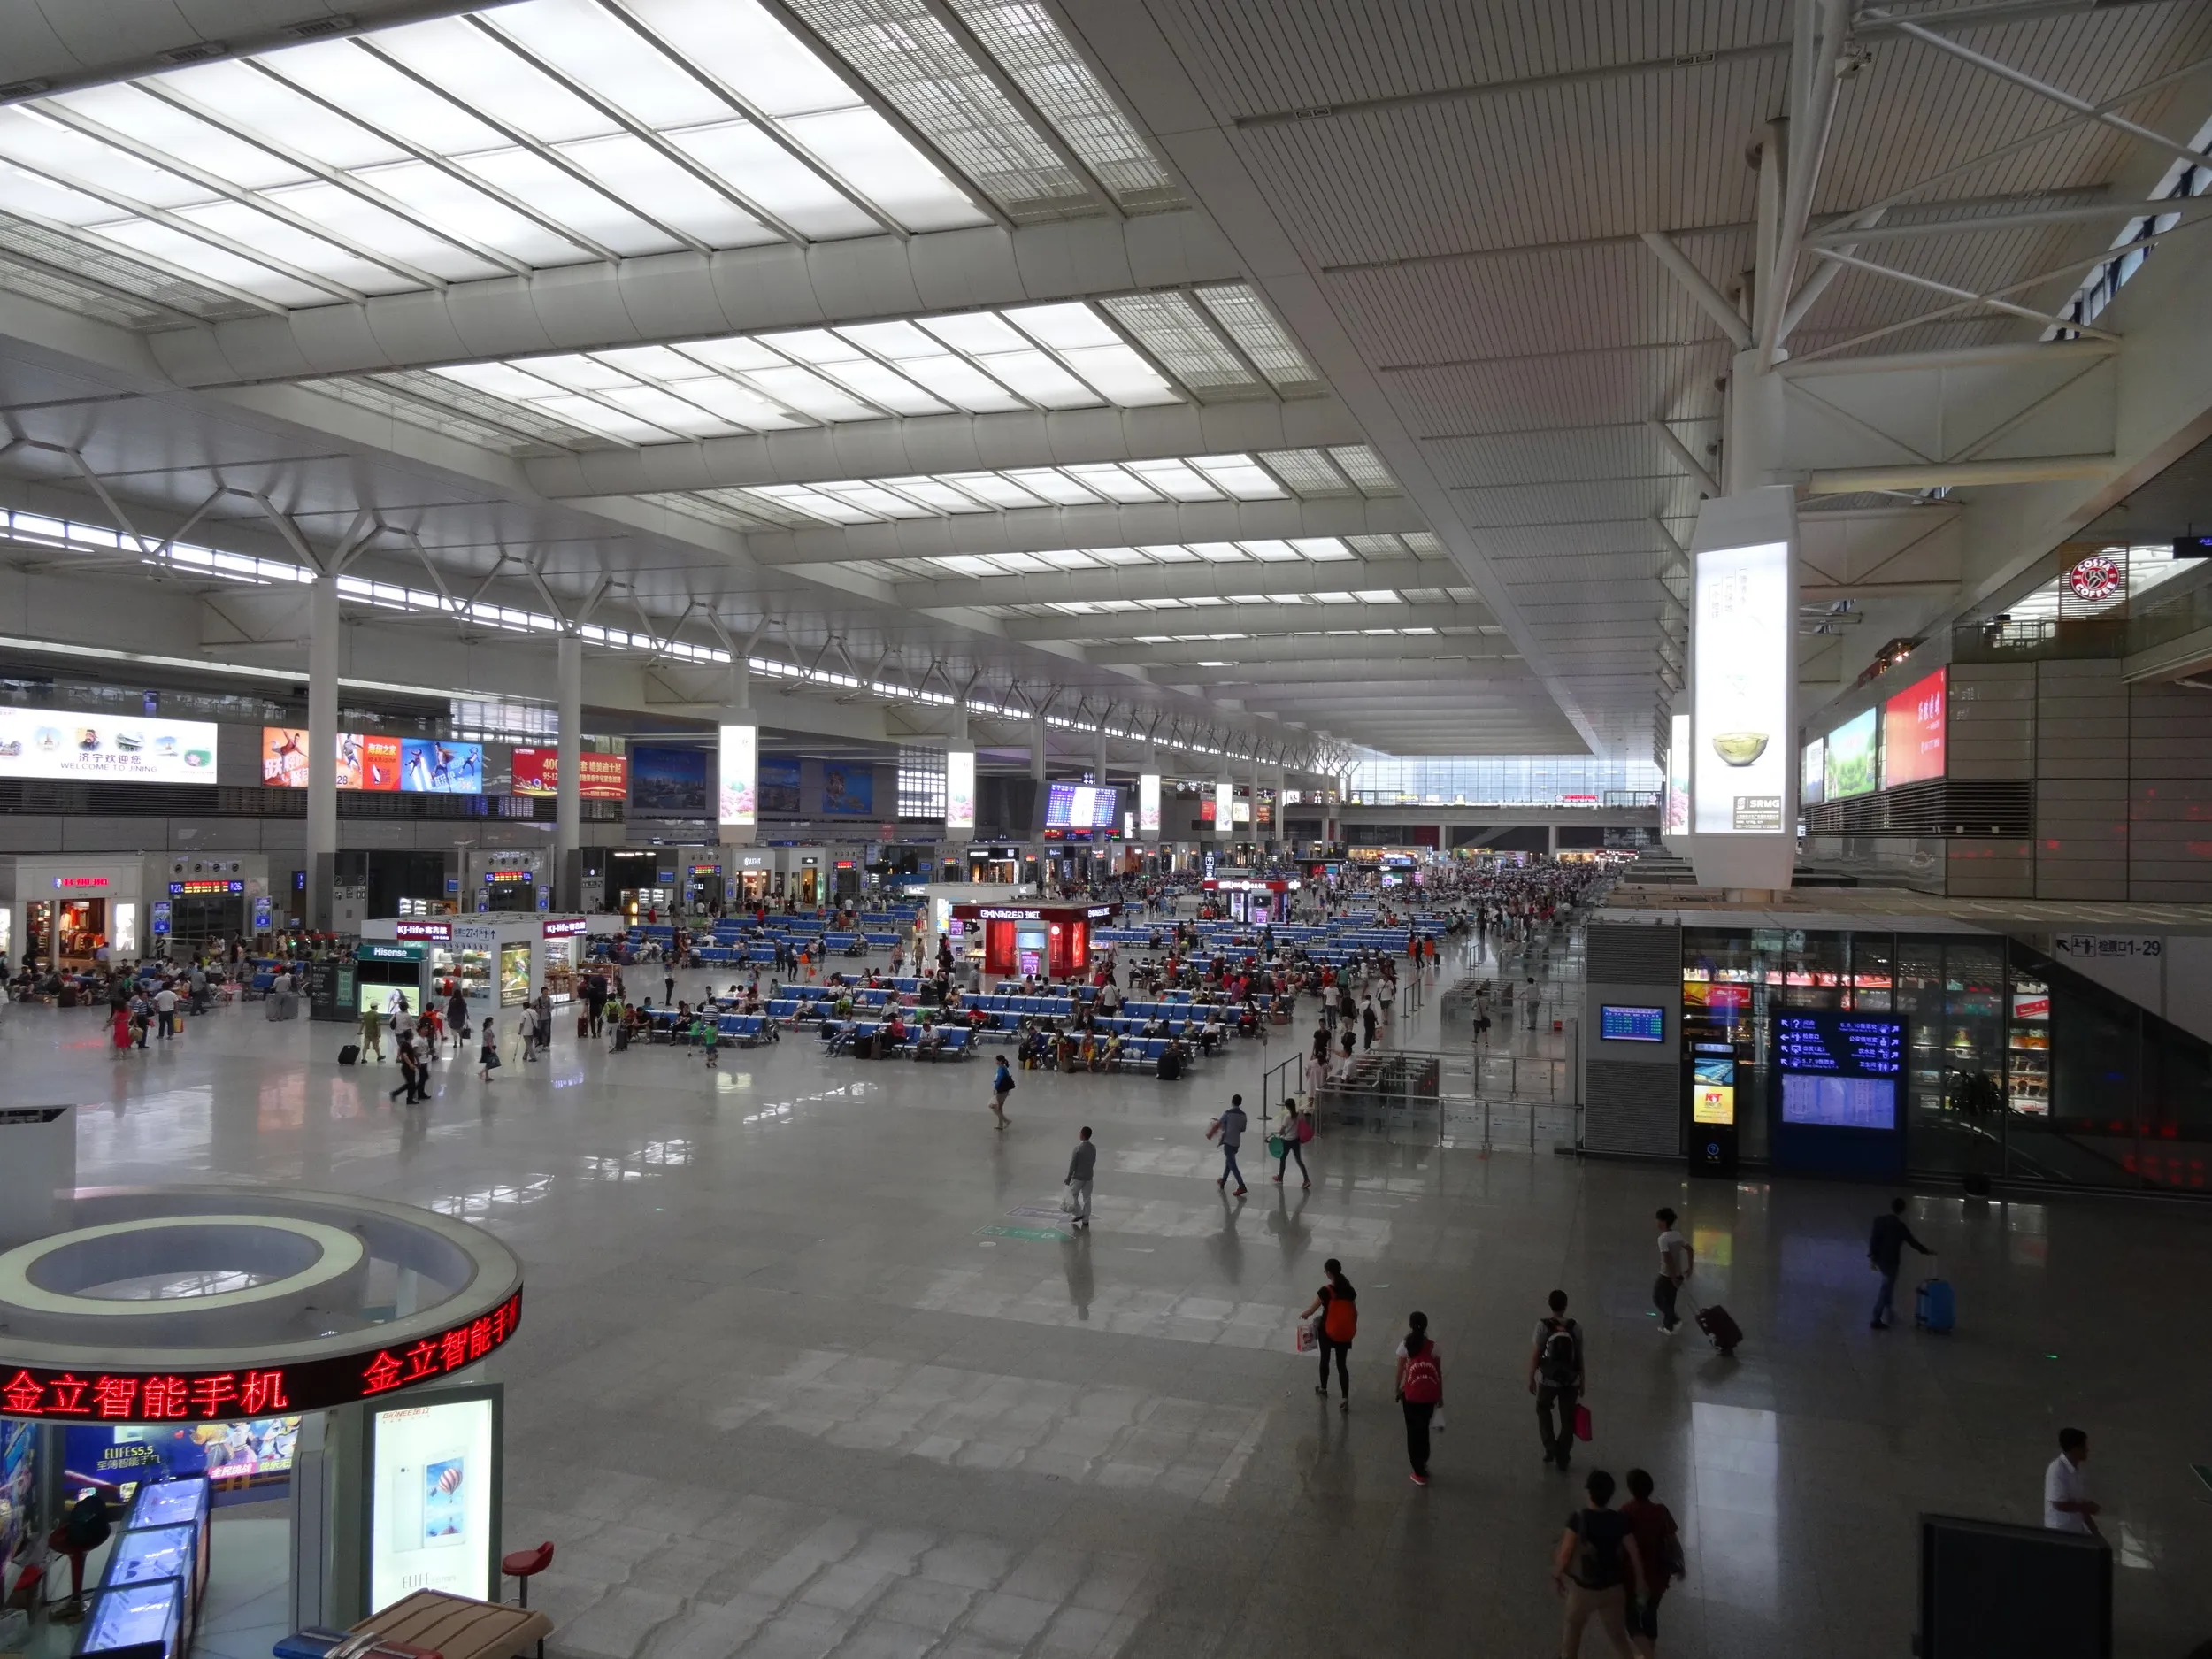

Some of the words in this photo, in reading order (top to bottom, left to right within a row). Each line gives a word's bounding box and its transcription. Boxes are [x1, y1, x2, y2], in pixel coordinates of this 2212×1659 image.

[2078, 558, 2113, 572] COSTA
[2075, 581, 2116, 598] COFFEE
[79, 752, 141, 764] 济宁欢迎您
[60, 762, 109, 771] WELCOME
[1749, 799, 1779, 808] SRMG
[373, 947, 408, 957] Hisense
[361, 1294, 520, 1395] 金立智能手机
[2, 1371, 289, 1418] 金立智能手机
[211, 1463, 253, 1478] 全民挑战
